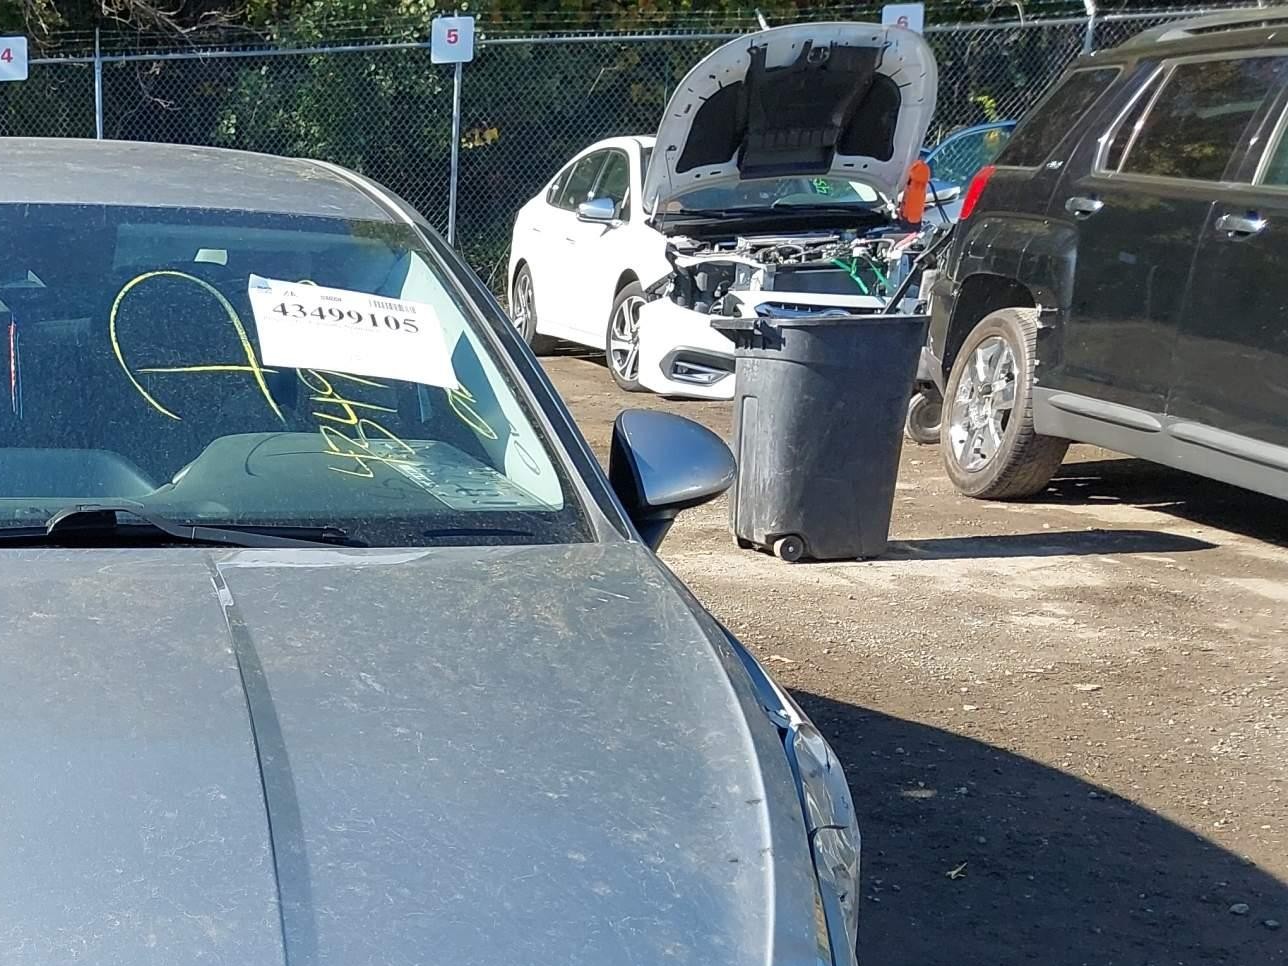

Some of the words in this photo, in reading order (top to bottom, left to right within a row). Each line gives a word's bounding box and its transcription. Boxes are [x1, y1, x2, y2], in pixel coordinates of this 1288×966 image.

[897, 15, 908, 29] 6
[447, 28, 459, 44] 5
[0, 47, 14, 63] 4
[272, 302, 419, 334] 43499105
